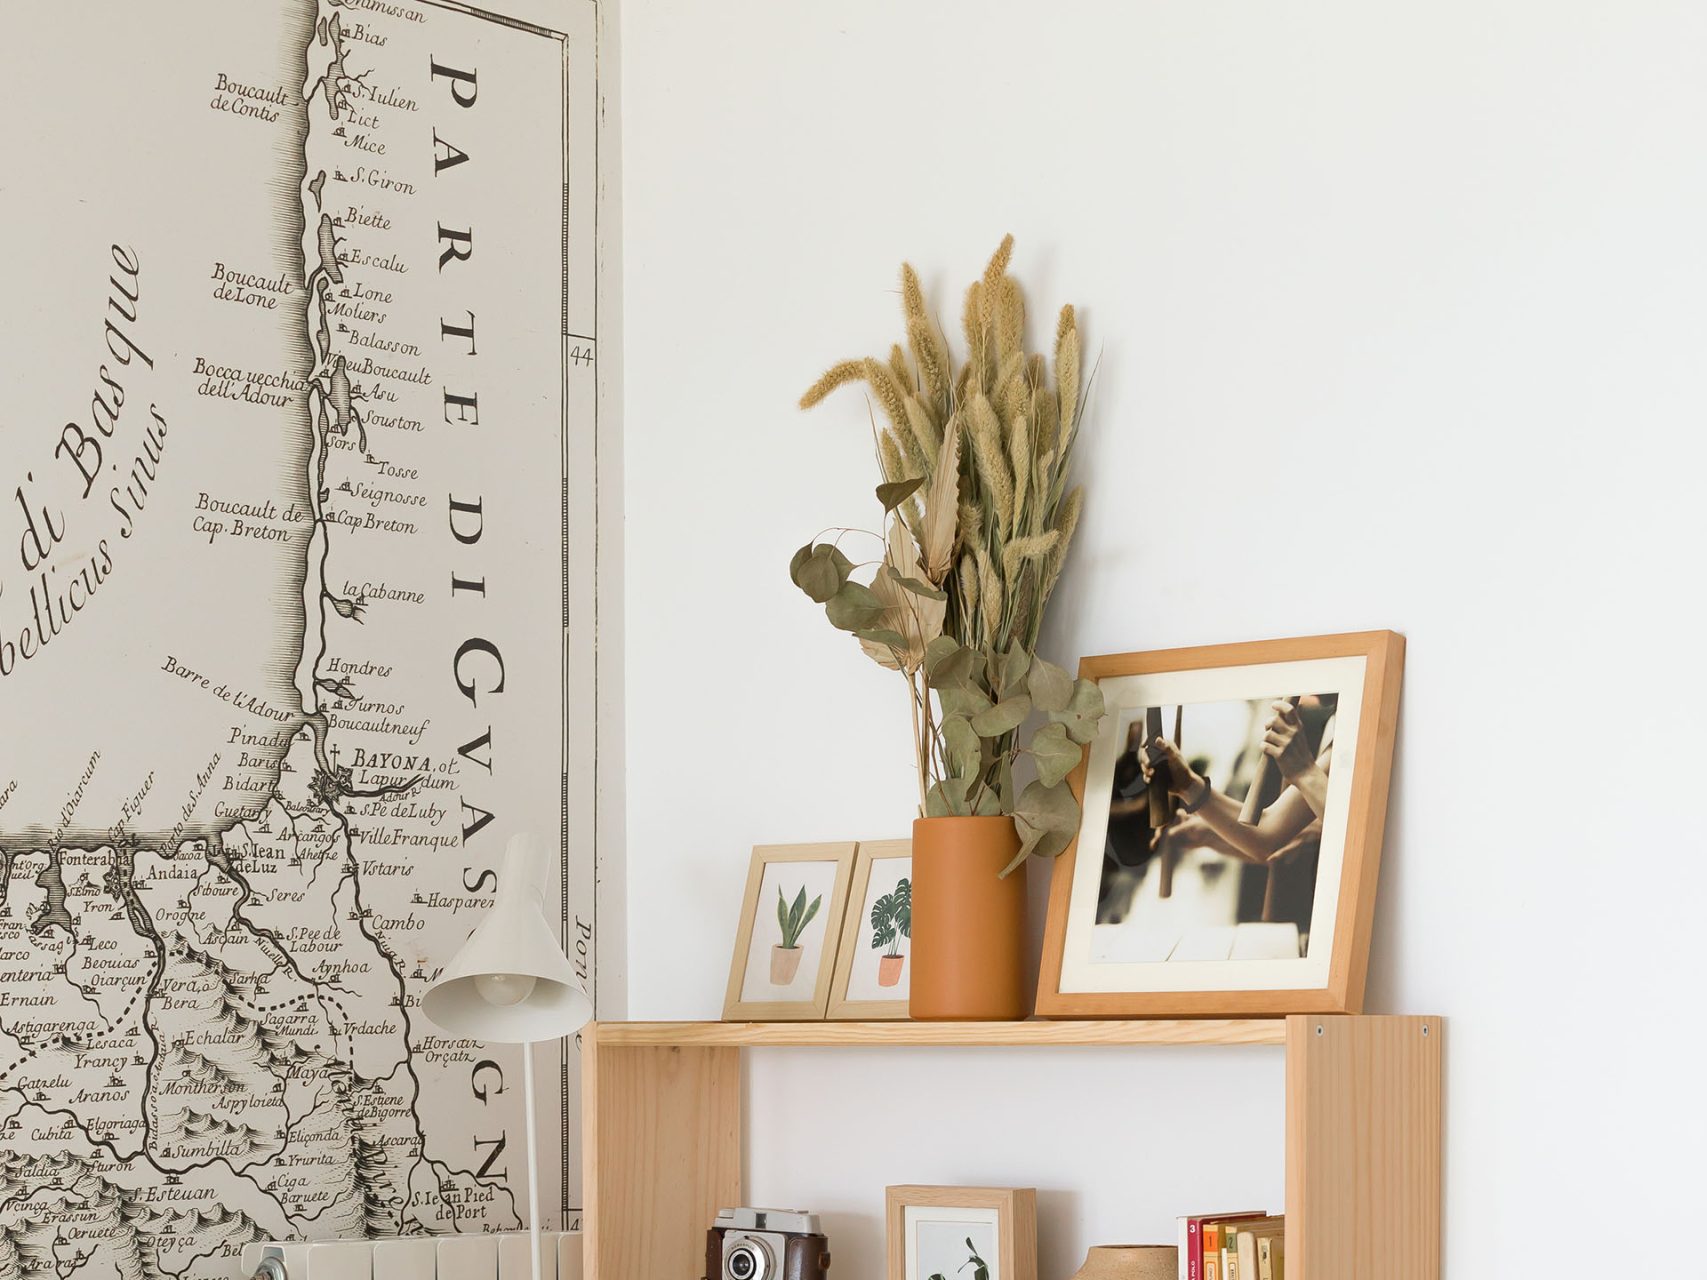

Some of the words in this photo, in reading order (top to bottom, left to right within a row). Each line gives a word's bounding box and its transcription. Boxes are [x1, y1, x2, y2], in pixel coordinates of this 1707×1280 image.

[352, 24, 388, 47] Bias
[215, 73, 299, 106] Boucault
[344, 133, 386, 155] Mice
[344, 205, 392, 230] Biette
[350, 248, 409, 274] Escalu
[211, 263, 295, 295] Boucault
[353, 282, 393, 304] Lone
[349, 330, 422, 357] Balasson
[570, 345, 594, 367] 44
[193, 357, 242, 381] Bocca
[14, 471, 66, 573] di
[56, 244, 154, 500] Basque
[361, 409, 424, 432] Souston
[325, 435, 356, 451] Sors
[109, 403, 169, 539] Sinus
[377, 460, 418, 480] Tosse
[350, 479, 428, 507] Seignosse
[195, 492, 277, 520] Boucault
[282, 504, 305, 522] de
[231, 519, 292, 542] Breton
[326, 657, 393, 678] Hondres
[161, 655, 210, 689] Barre
[213, 685, 231, 702] de
[223, 773, 274, 792] Bidart
[146, 863, 199, 881] Andaia
[361, 856, 414, 877] Vstaris
[266, 888, 306, 902] Seres
[83, 900, 115, 913] Yron
[155, 908, 207, 926] Orogne
[372, 912, 426, 931] Cambo
[289, 940, 344, 953] Labour
[311, 958, 373, 980] Aynhoa
[161, 996, 201, 1010] Bera
[260, 1012, 321, 1030] Sagarra
[275, 1023, 319, 1036] Mundi
[343, 1020, 397, 1036] Vrdache
[86, 1038, 138, 1051] Lesaca
[184, 1026, 246, 1047] Echalar
[287, 1065, 330, 1087] Maya
[68, 1088, 130, 1104] Aranos
[277, 1172, 311, 1192] Ciga
[280, 1190, 330, 1205] Baruete
[464, 1184, 495, 1204] Pied
[456, 1203, 488, 1220] Port
[1190, 1224, 1195, 1233] 3
